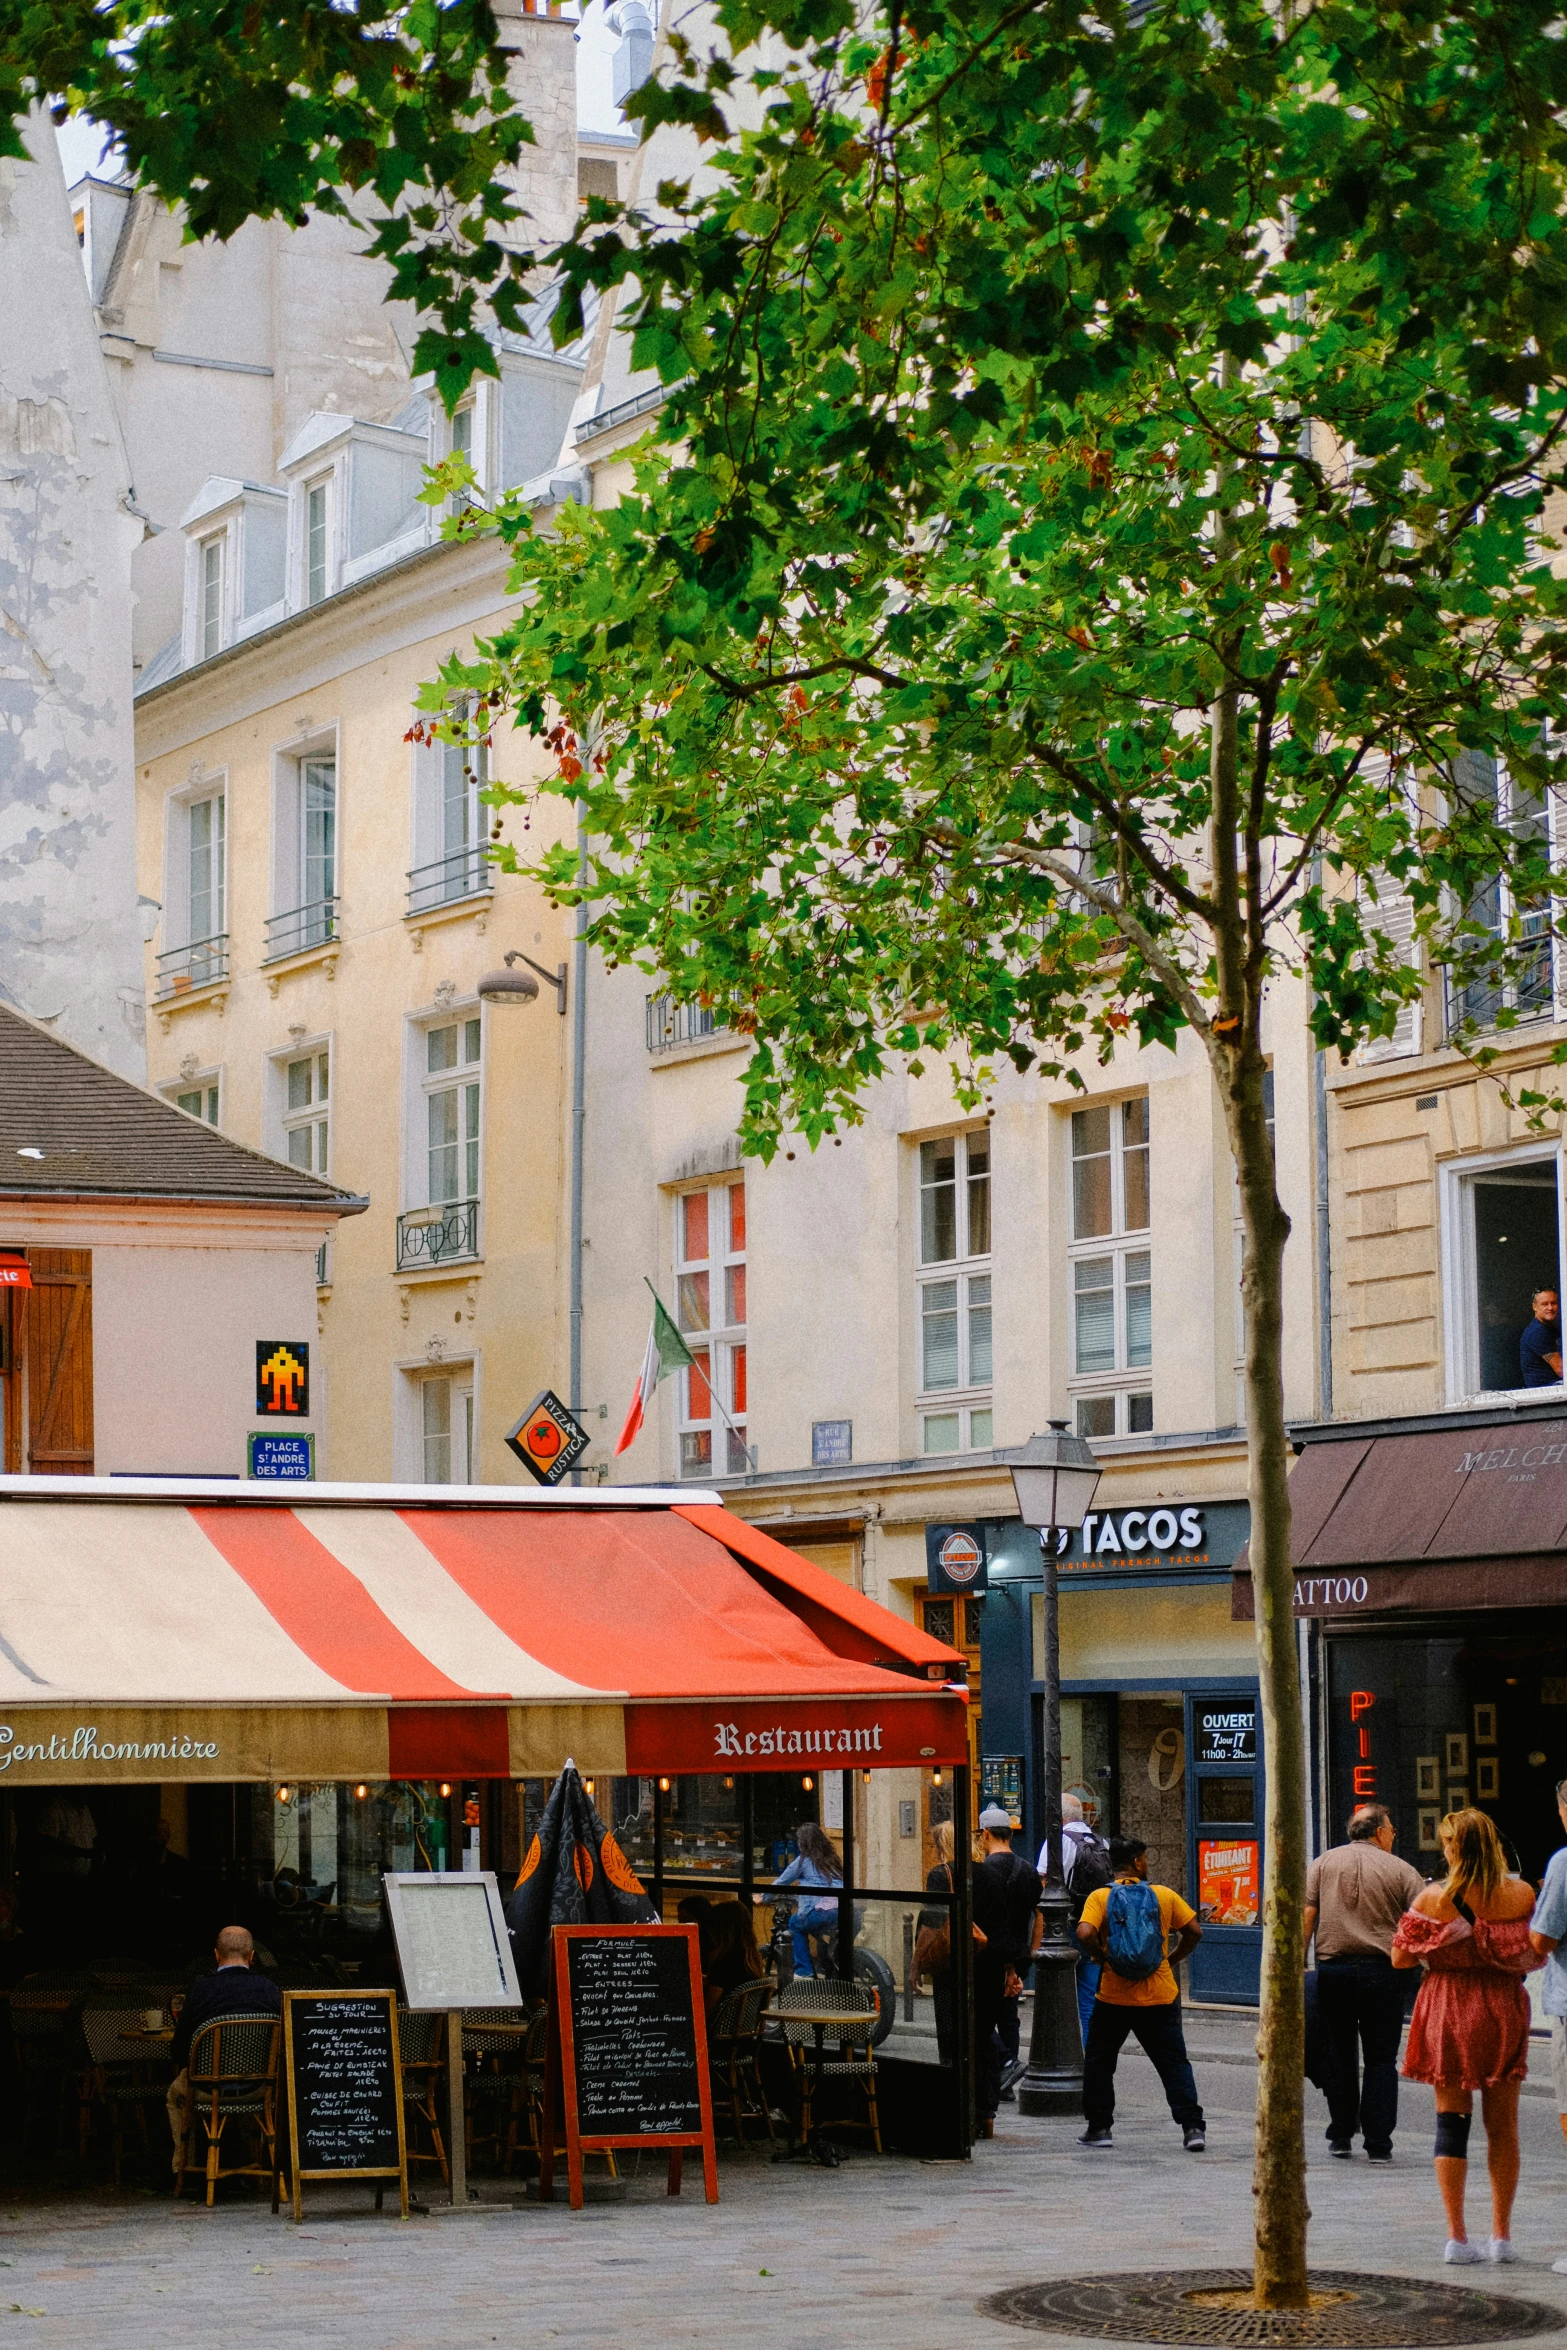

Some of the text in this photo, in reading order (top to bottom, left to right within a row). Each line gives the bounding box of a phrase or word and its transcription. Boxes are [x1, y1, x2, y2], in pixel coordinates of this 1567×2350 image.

[545, 1398, 571, 1433] PIZZA
[265, 1442, 299, 1452] PLACE
[547, 1435, 585, 1481] RUSTICA
[257, 1466, 306, 1476] DES ARTS
[1508, 1474, 1537, 1482] PARIS
[1112, 1558, 1160, 1568] FRENCH
[1169, 1554, 1209, 1565] TACOS
[1203, 1714, 1255, 1728] OUVERT
[713, 1722, 883, 1756] Restaurant
[0, 1726, 220, 1770] Gentilhommière
[1202, 1749, 1226, 1759] 11h00
[595, 1940, 636, 1948] FORMULE
[316, 2002, 377, 2012] SUGGESTION
[310, 2091, 338, 2100] CUISSE
[339, 2090, 351, 2098] DE
[311, 2107, 341, 2116] POMMES
